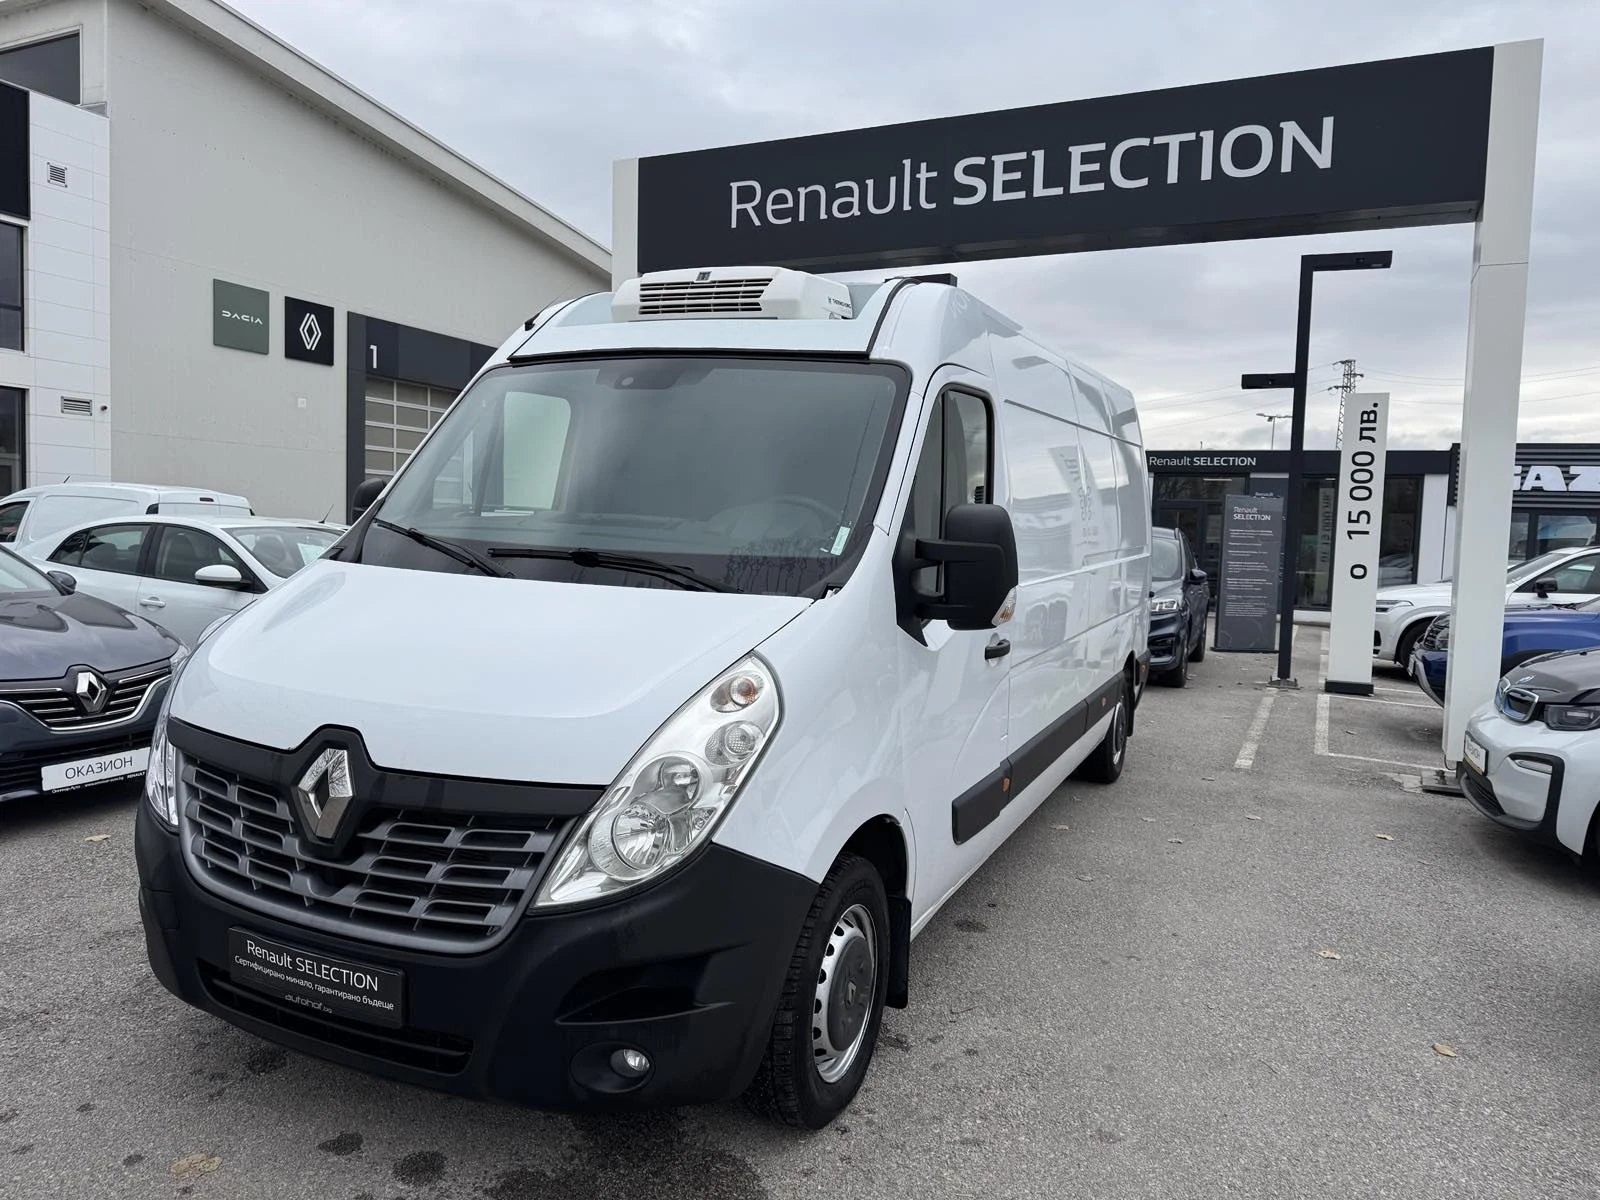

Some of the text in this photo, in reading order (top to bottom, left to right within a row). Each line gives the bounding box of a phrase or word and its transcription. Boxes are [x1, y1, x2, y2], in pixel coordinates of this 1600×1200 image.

[728, 115, 1336, 230] Renault SELECTION
[221, 309, 264, 326] DACIA
[368, 344, 379, 369] 1
[1149, 455, 1257, 467] Renault SELECTION
[1348, 450, 1375, 501] 000
[1513, 465, 1600, 492] AZ
[1232, 513, 1272, 521] SELECTION
[1233, 506, 1258, 514] Renault
[1346, 509, 1372, 541] 15
[65, 756, 133, 780] ОКАЗИОН
[246, 939, 379, 992] Renault SELECTION
[234, 955, 394, 1011] Сертифицирано минало, гарантирано бъдеще
